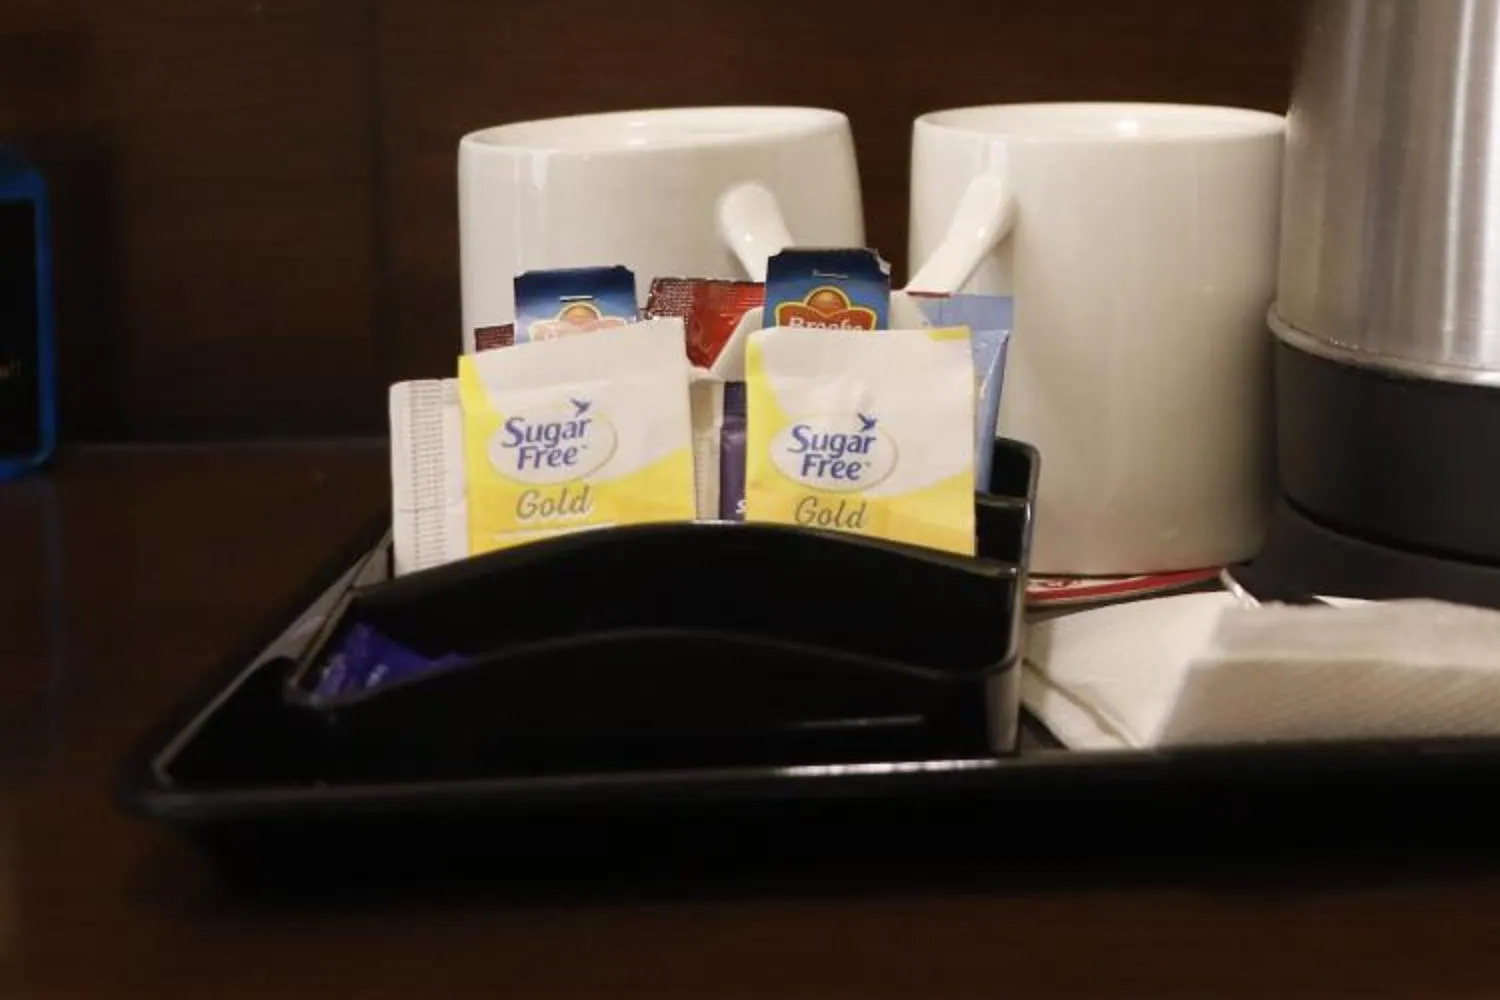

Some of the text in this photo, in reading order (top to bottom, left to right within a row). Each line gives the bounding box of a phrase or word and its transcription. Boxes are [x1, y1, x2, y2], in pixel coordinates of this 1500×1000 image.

[501, 417, 593, 449] Sugar
[787, 424, 877, 459] Sugar
[516, 484, 592, 520] Gold
[794, 495, 868, 529] Gold
